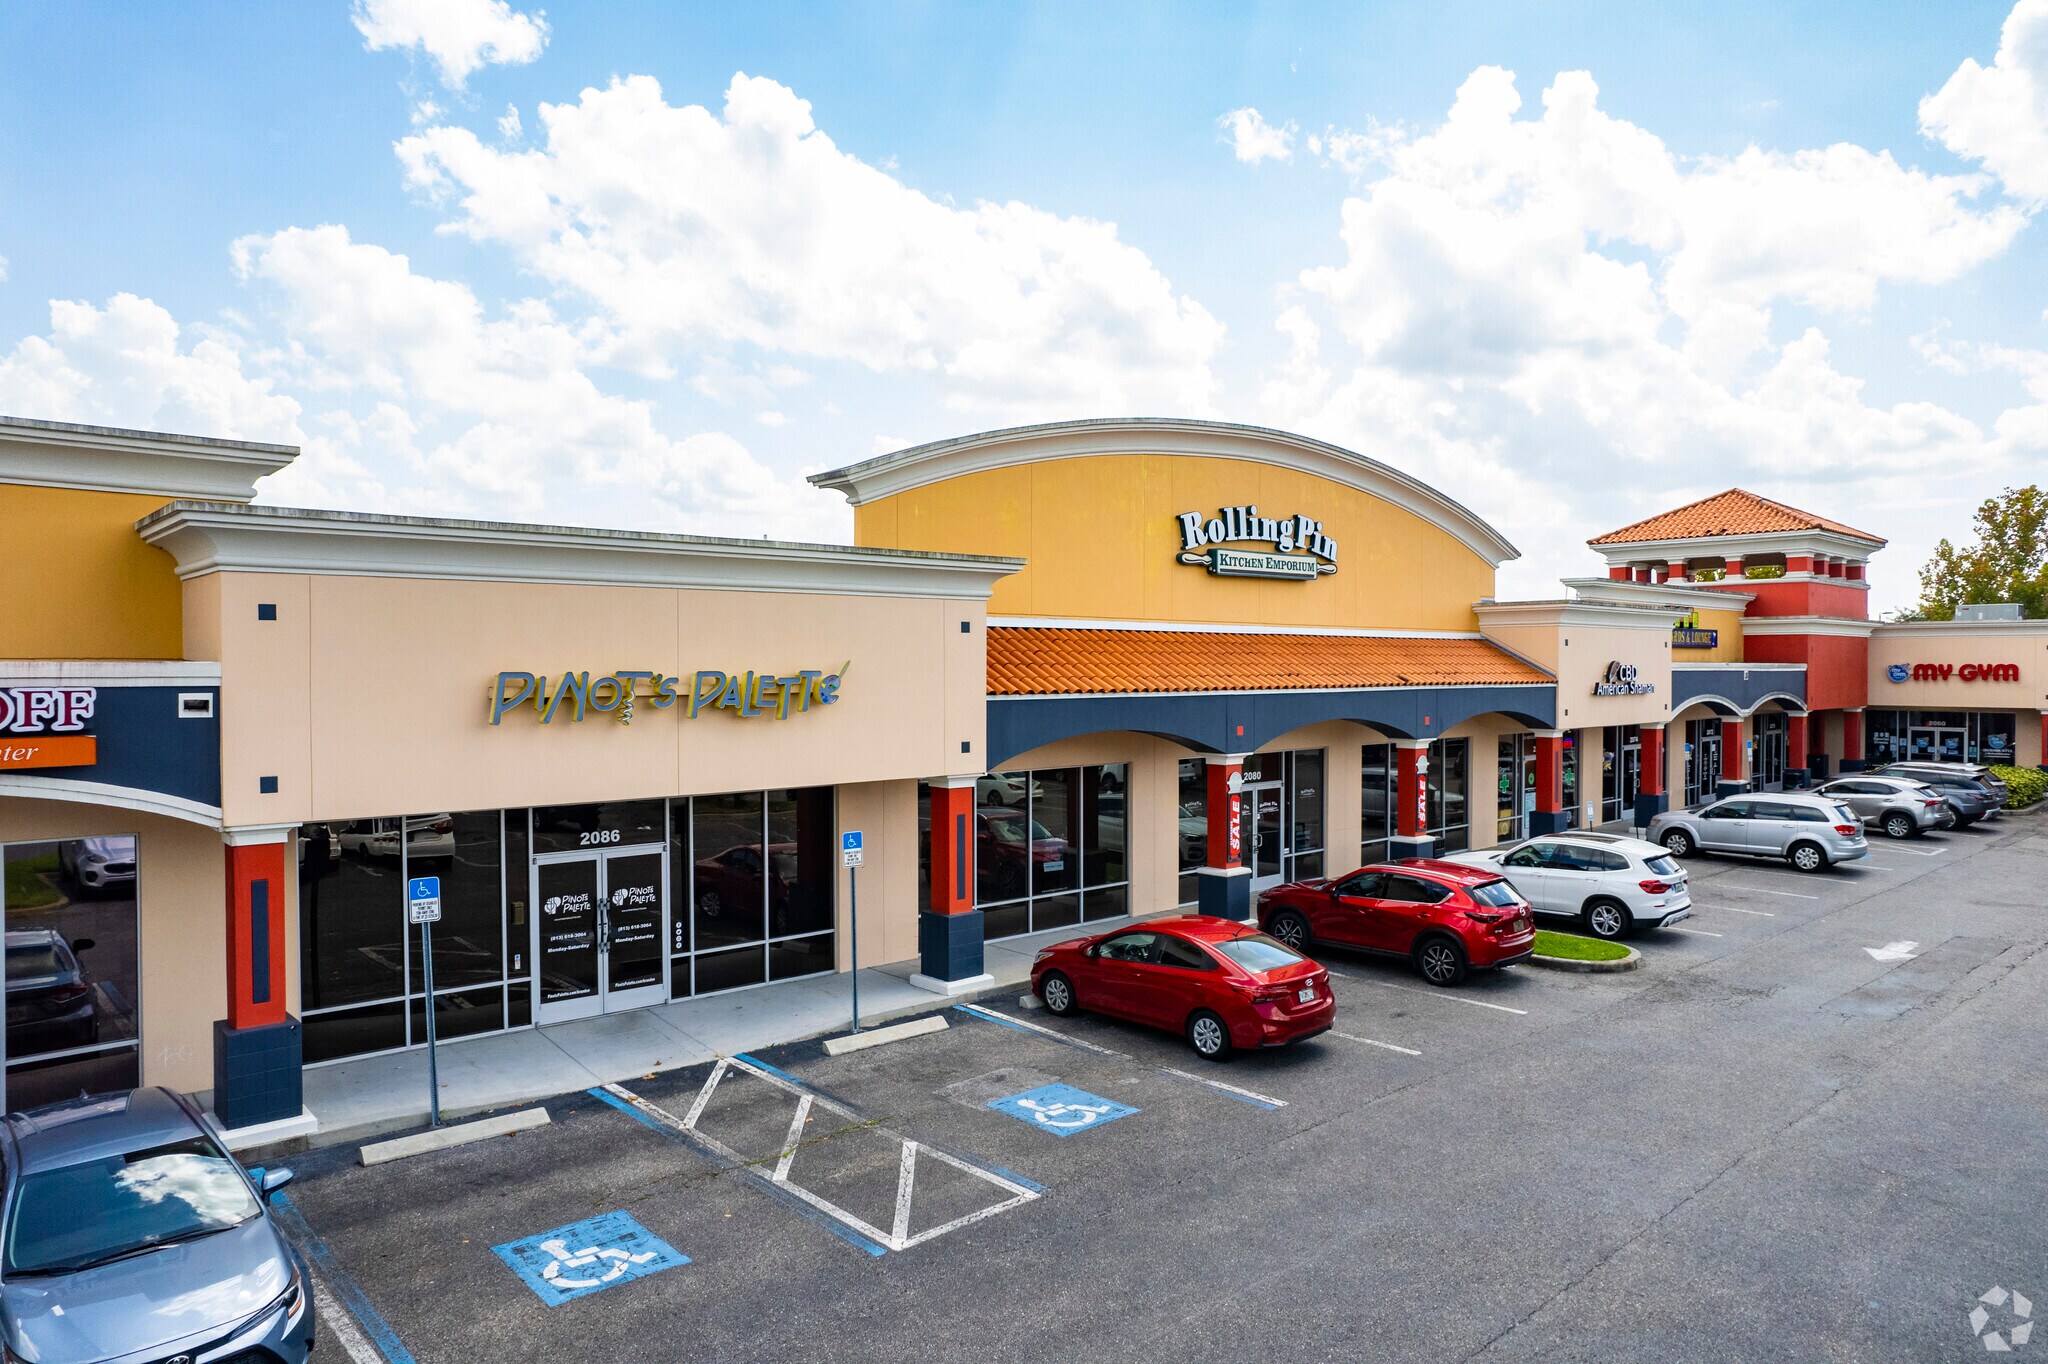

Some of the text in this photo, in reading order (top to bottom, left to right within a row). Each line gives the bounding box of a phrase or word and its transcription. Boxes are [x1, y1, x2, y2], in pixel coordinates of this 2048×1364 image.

[1219, 553, 1315, 572] KITCHEN EMPORIUM
[1692, 632, 1711, 644] LOUNGE
[1620, 665, 1637, 681] CBD
[1597, 681, 1654, 696] American Shaman
[489, 670, 679, 725] PINOT'S
[0, 687, 96, 732] FF
[0, 746, 39, 761] ter
[1243, 771, 1262, 781] 2080
[1232, 800, 1240, 850] SALE
[580, 830, 620, 845] 2086
